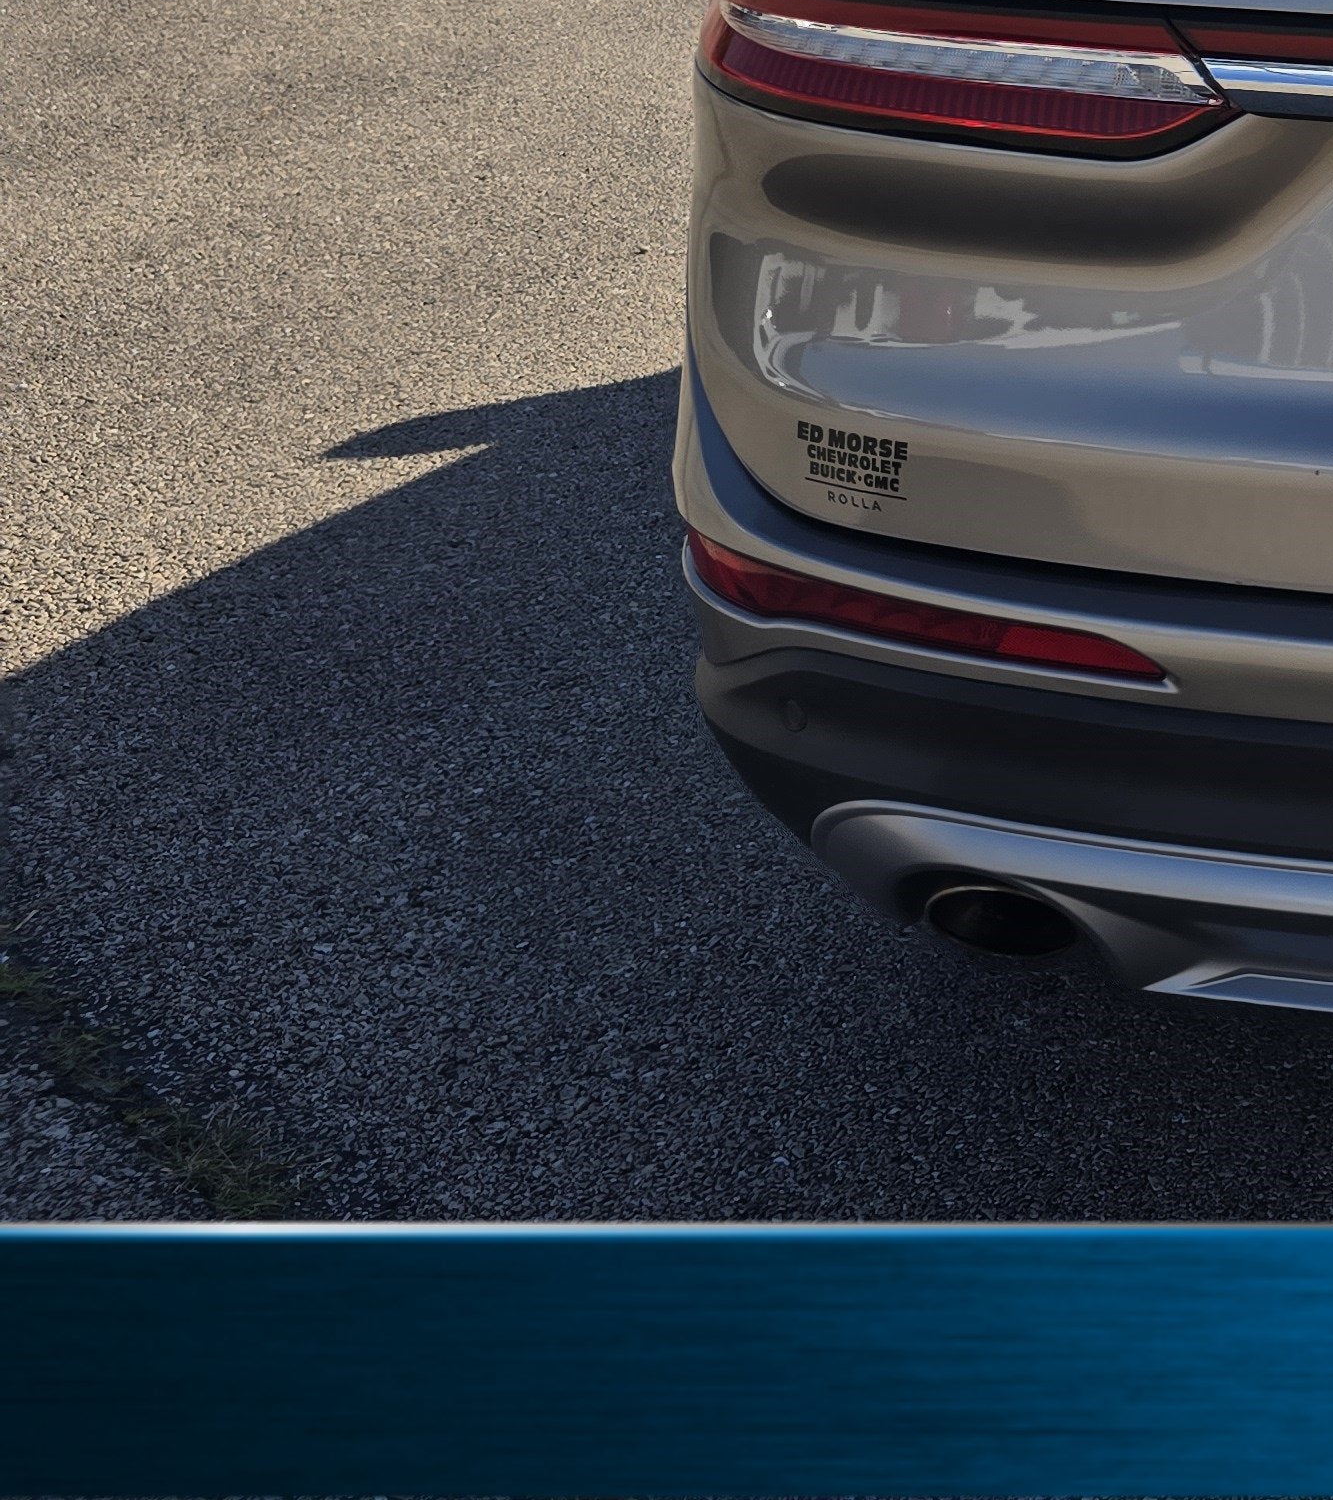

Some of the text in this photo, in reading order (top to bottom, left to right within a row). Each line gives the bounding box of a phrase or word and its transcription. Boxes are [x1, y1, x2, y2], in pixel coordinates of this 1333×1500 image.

[797, 420, 909, 461] ED MORSE
[806, 444, 903, 477] CHEVROLET
[827, 490, 882, 512] ROLLA
